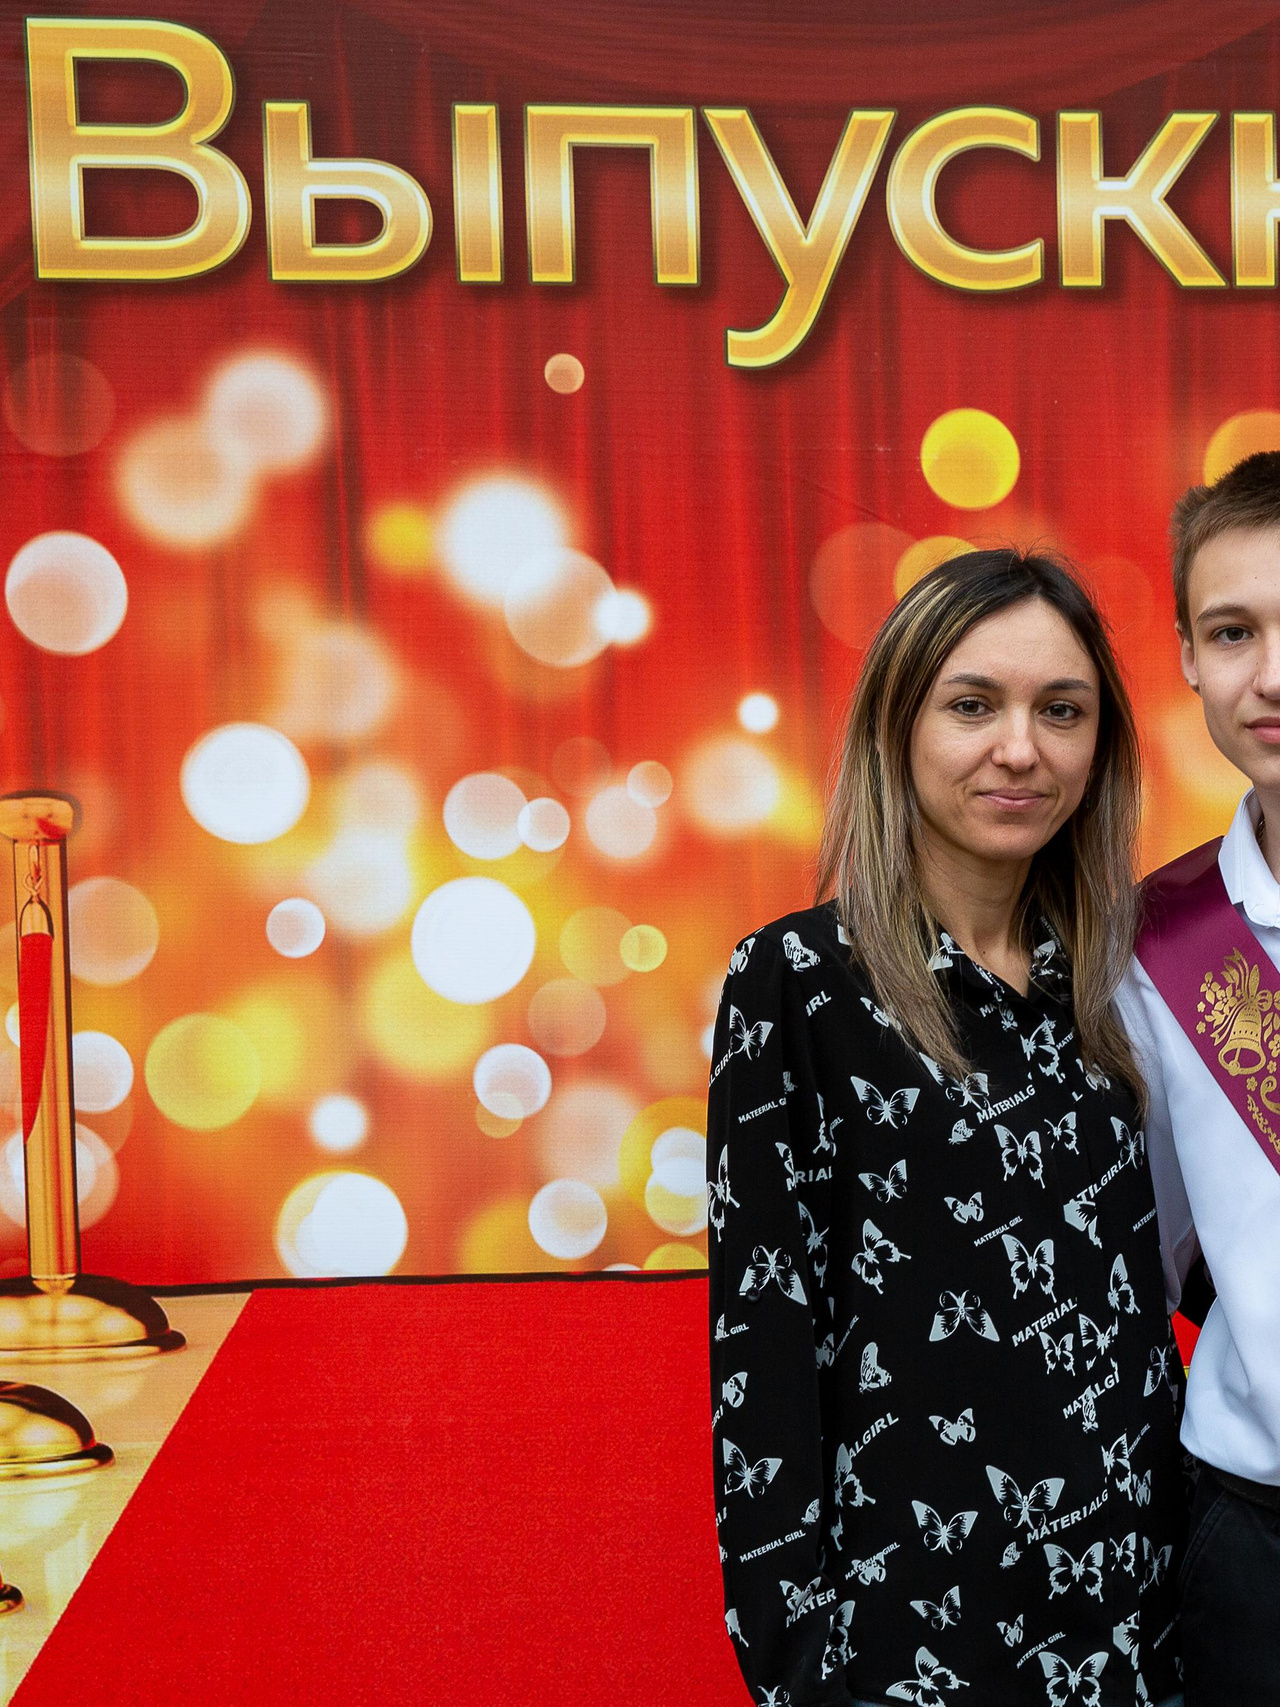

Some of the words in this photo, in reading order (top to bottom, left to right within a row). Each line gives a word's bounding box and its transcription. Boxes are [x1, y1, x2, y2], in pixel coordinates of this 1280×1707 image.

[976, 1084, 1037, 1124] MATERIALG
[730, 1322, 750, 1335] GIRL
[1011, 1297, 1078, 1348] MATERIAL
[784, 1529, 807, 1544] GIRL
[1026, 1489, 1109, 1545] MATERIALG
